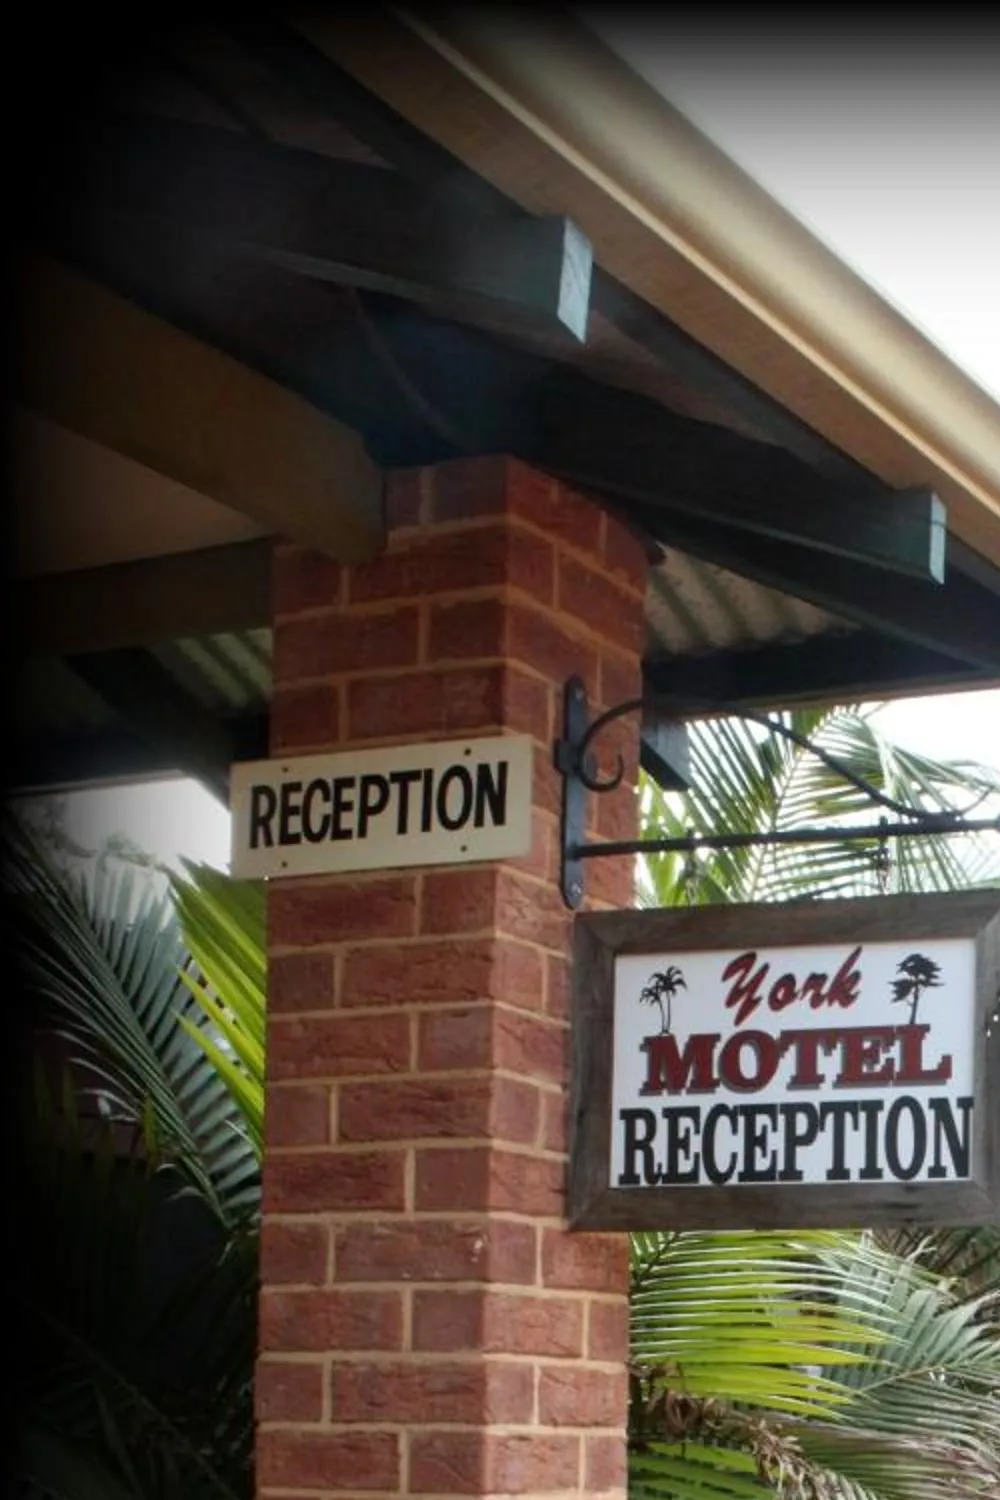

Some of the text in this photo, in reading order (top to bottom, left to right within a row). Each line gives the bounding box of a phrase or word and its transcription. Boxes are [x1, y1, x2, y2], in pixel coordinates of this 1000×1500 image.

[250, 761, 509, 849] RECEPTION
[721, 946, 863, 1026] York
[639, 1024, 952, 1096] MOTEL
[618, 1095, 975, 1185] RECEPTION
